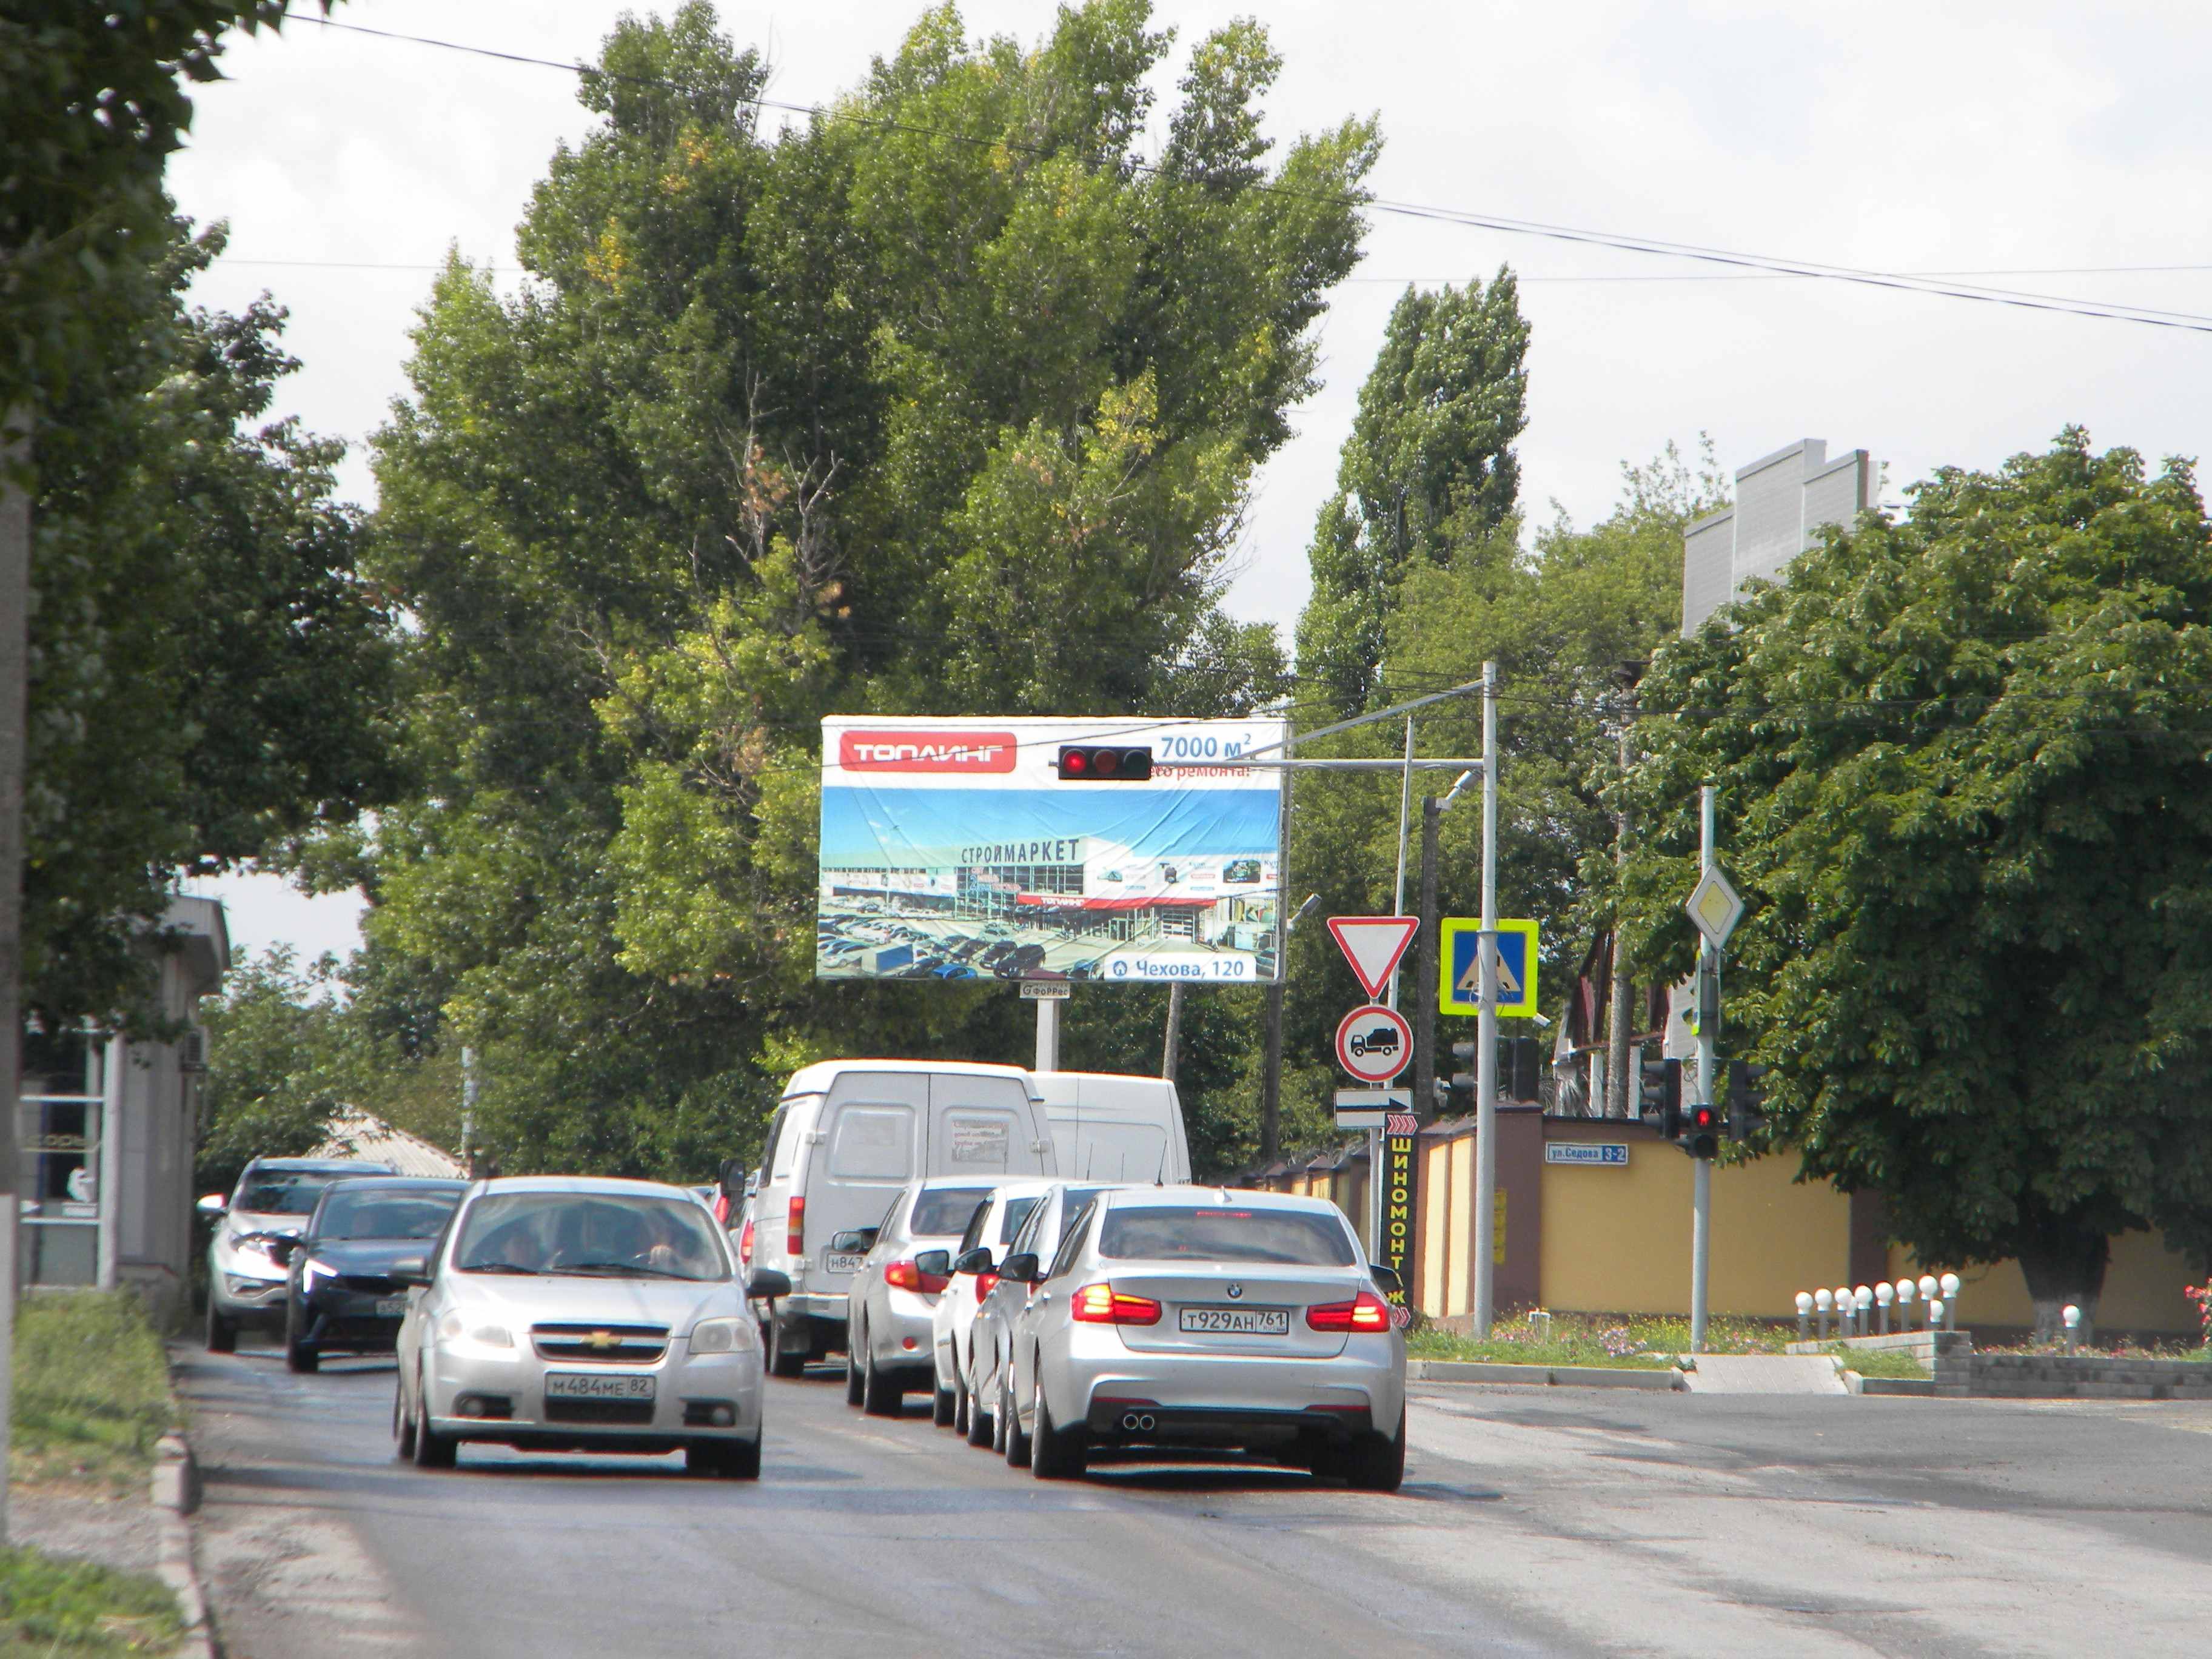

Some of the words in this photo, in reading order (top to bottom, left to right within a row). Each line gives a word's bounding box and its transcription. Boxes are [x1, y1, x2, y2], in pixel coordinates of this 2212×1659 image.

[853, 743, 1003, 762] ТОПЛИНГ
[1161, 736, 1217, 758] 7000
[961, 839, 1079, 863] СТРОЙМАРКЕТ
[1136, 959, 1205, 979] Чехова,
[1213, 960, 1244, 976] 120
[1605, 1147, 1625, 1161] 3-2
[1258, 1312, 1282, 1327] 761
[630, 1378, 648, 1392] 82
